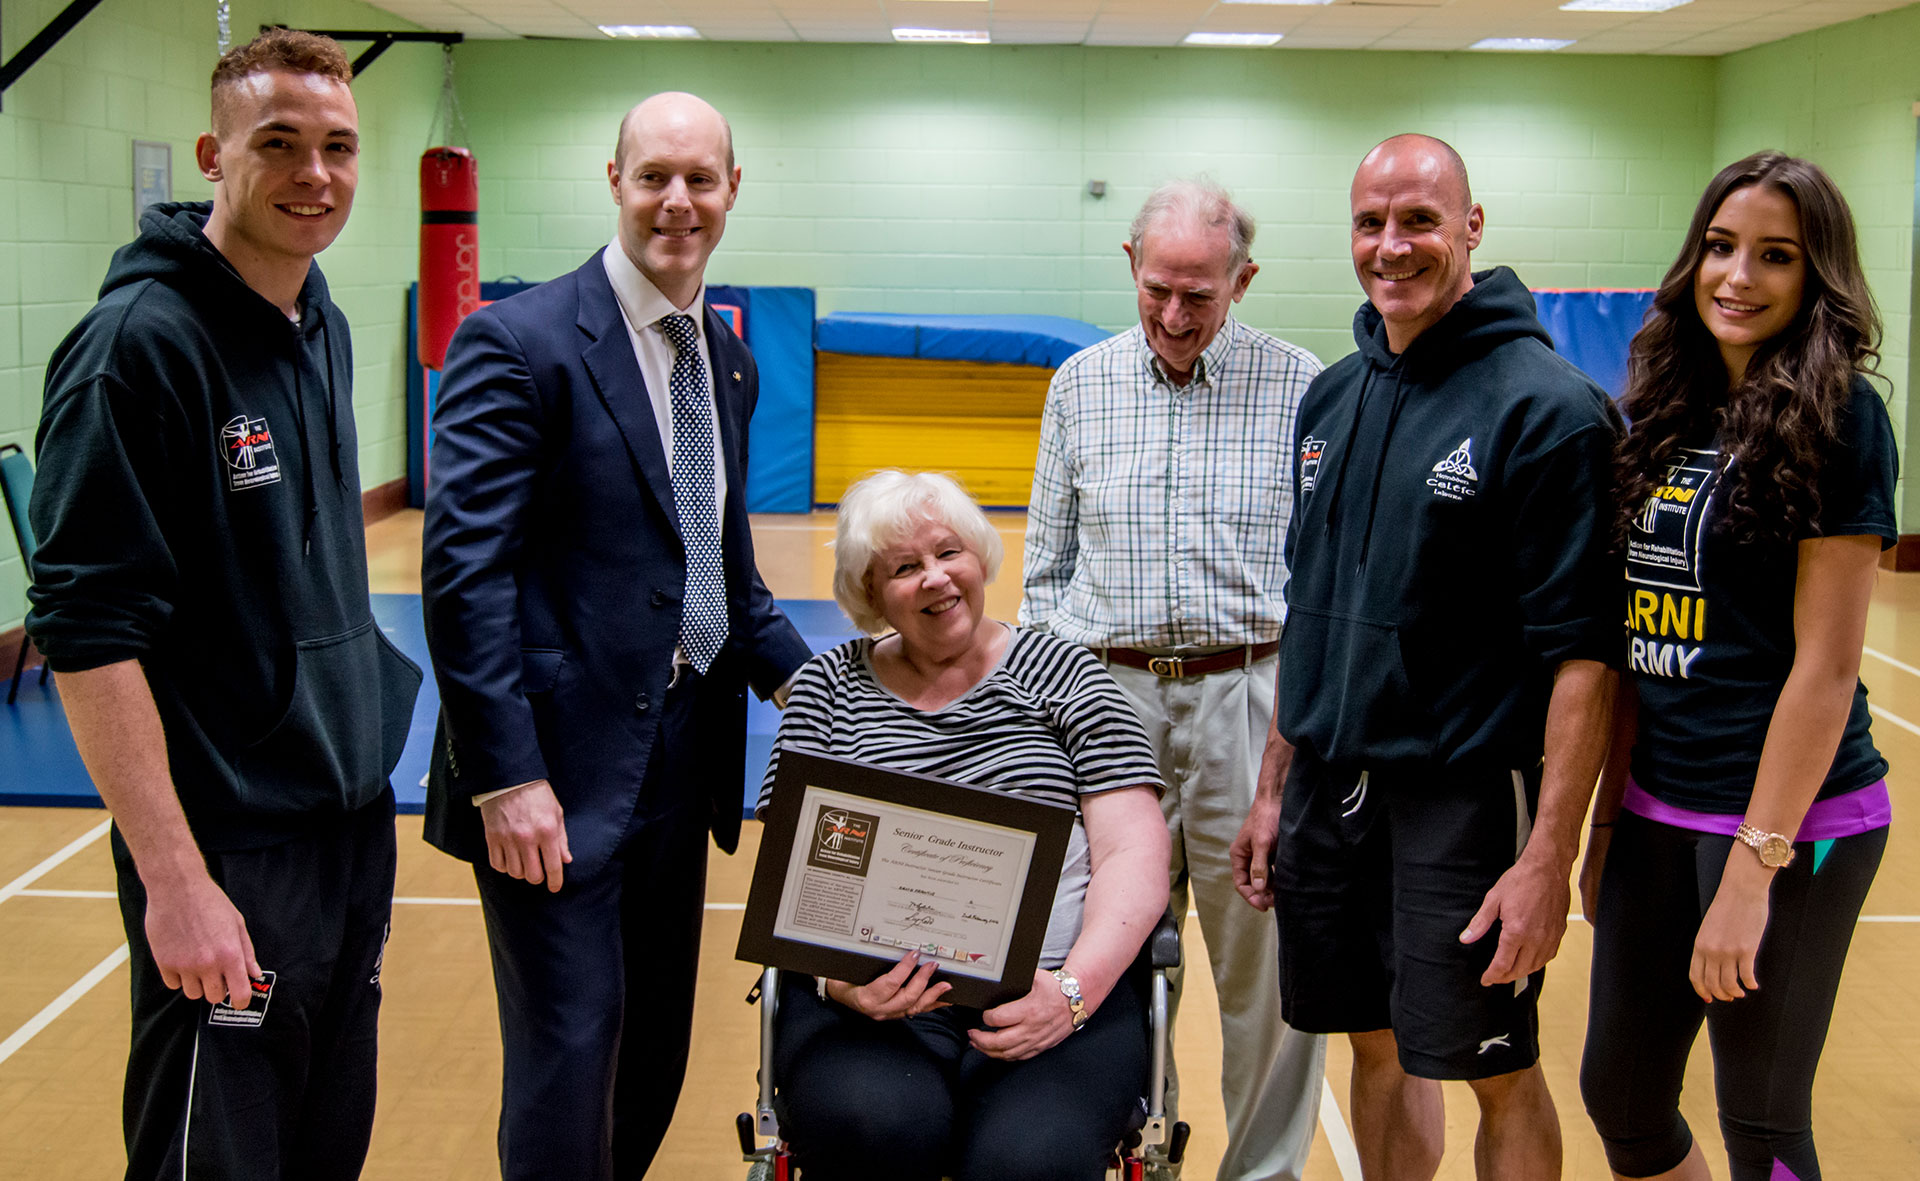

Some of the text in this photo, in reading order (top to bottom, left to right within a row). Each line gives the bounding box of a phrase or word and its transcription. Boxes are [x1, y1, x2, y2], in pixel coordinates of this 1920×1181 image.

[230, 431, 269, 449] ARNI
[1680, 477, 1694, 485] THE
[1658, 503, 1688, 515] INSTITUTE
[1628, 636, 1700, 680] RMY
[893, 827, 1004, 857] Senior Grade Instructor
